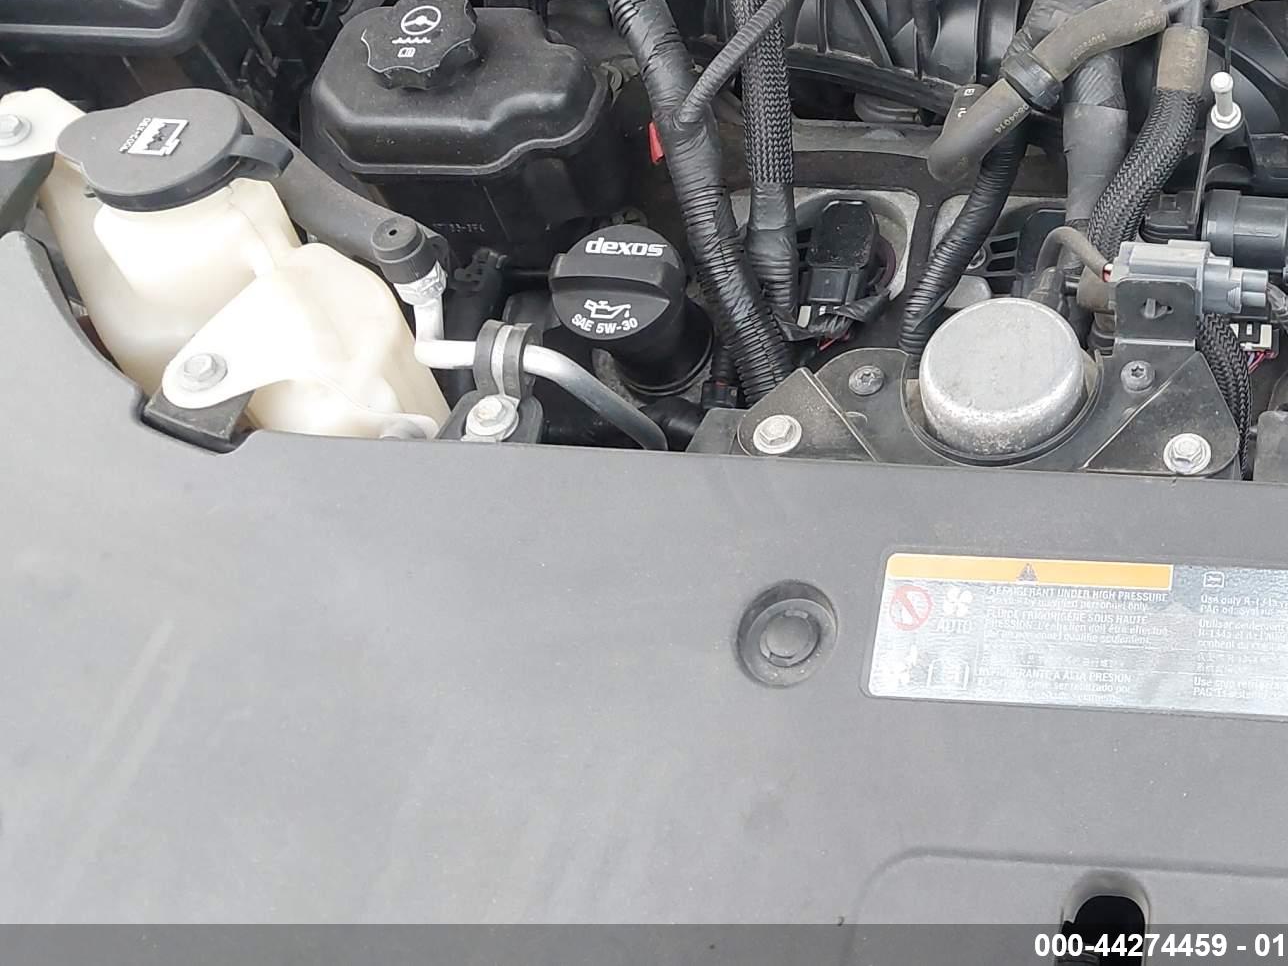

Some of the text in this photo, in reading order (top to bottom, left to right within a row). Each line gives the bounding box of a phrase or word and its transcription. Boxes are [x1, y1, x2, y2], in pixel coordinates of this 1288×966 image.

[585, 237, 668, 257] dexos
[571, 313, 638, 334] SAE 5W-30
[1058, 588, 1090, 599] UNDER
[1092, 590, 1116, 600] HIGH
[1118, 591, 1169, 602] PRESSURE
[936, 618, 973, 633] AUTO
[1088, 613, 1114, 623] SOUS
[1116, 614, 1148, 625] HAUTE
